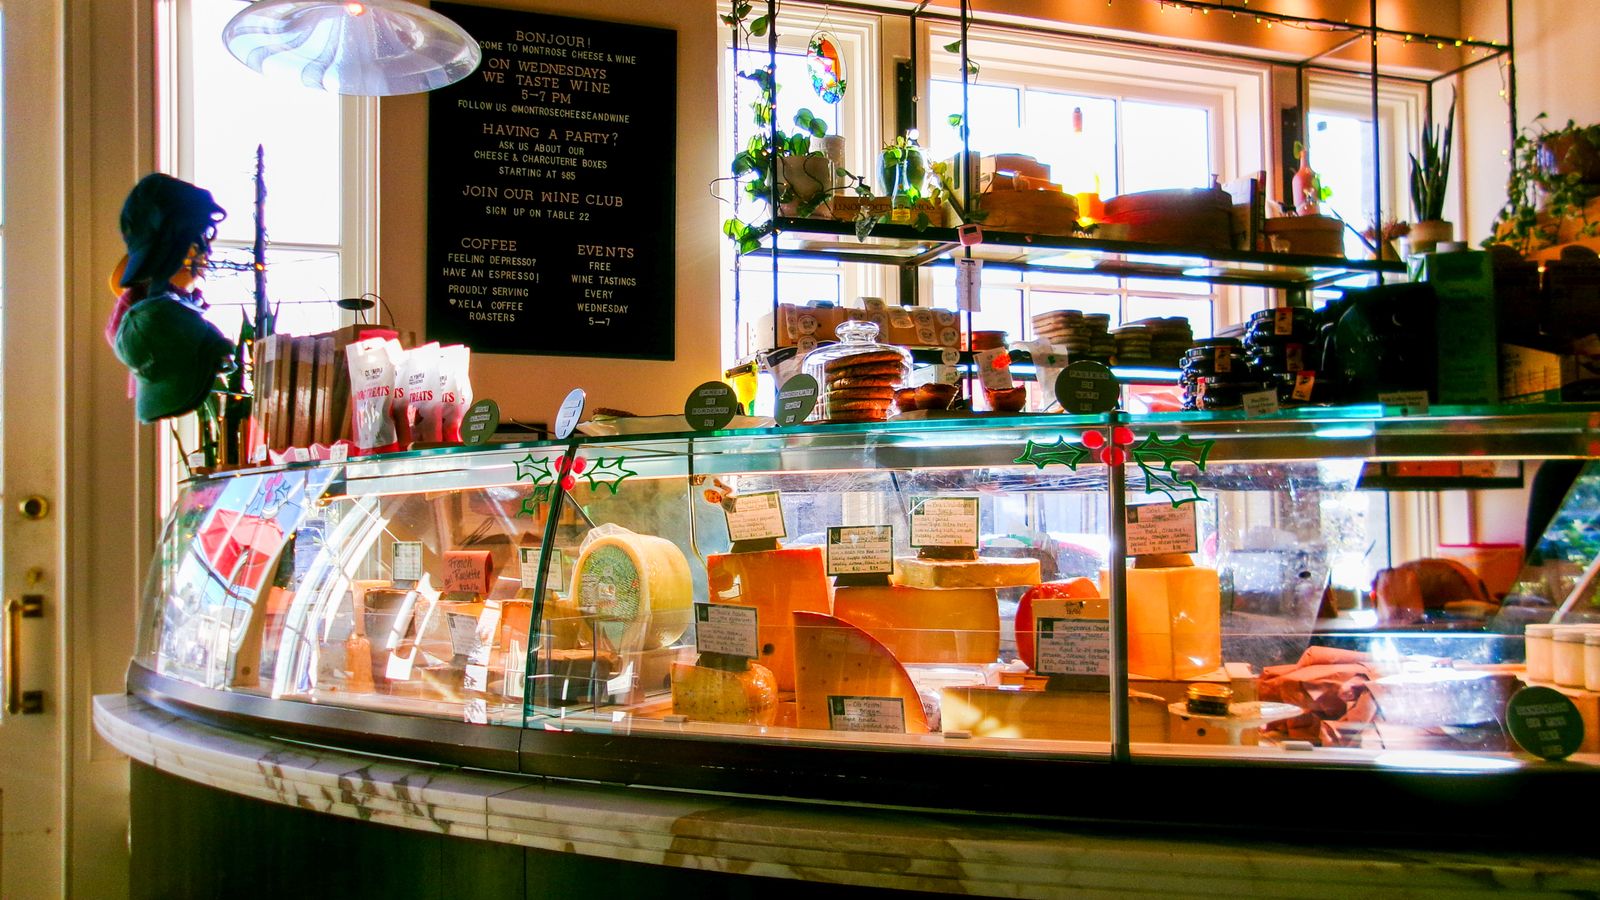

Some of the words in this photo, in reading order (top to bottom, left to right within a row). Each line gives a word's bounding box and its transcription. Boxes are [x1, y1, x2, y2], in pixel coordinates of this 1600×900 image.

[516, 30, 591, 48] BONJOUR!
[479, 41, 503, 51] COME
[507, 43, 518, 53] TO
[523, 45, 566, 57] MONTROSE
[572, 50, 603, 61] CHEESE
[607, 54, 612, 62] &
[615, 55, 636, 64] WINE
[489, 58, 510, 69] ON
[518, 60, 607, 80] WEDNESDAYS
[483, 71, 504, 83] WE
[516, 75, 559, 88] TASTE
[570, 80, 610, 94] WINE
[552, 92, 570, 104] PM
[458, 100, 492, 110] FOLLOW
[511, 105, 629, 123] @MONTROSECHEESEANDWINE
[483, 123, 539, 138] HAVING
[549, 129, 558, 140] A
[566, 130, 618, 146] PARTY?
[499, 141, 514, 149] ASK
[519, 142, 529, 151] US
[534, 144, 561, 153] ABOUT
[568, 146, 584, 155] OUR
[474, 150, 508, 161] CHEESE
[522, 154, 577, 166] CHARCUTERIE
[582, 159, 607, 169] BOXES
[499, 166, 541, 177] STARTING
[546, 170, 556, 178] AT
[561, 171, 576, 180] $85
[463, 185, 497, 197] JOIN
[504, 189, 533, 200] OUR
[542, 192, 579, 204] WINE
[586, 194, 623, 207] CLUB
[486, 206, 506, 215] SIGN
[514, 208, 525, 216] UP
[529, 209, 541, 217] ON
[547, 210, 574, 220] TABLE
[579, 213, 589, 221] 22
[461, 238, 516, 251] COFFEE
[578, 245, 634, 258] EVENTS
[448, 253, 484, 263] FEELING
[490, 256, 536, 266] DEPRESSO?
[589, 261, 611, 271] FREE
[443, 268, 466, 277] HAVE
[471, 269, 483, 277] AN
[489, 270, 539, 283] ESPRESSO!
[571, 275, 593, 284] WINE
[599, 276, 636, 286] TASTINGS
[449, 285, 487, 294] PROUDLY
[492, 287, 528, 297] SERVING
[585, 289, 613, 299] EVERY
[458, 300, 482, 308] XELA
[491, 301, 523, 311] COFFEE
[577, 303, 628, 313] WEDNESDAY
[469, 312, 515, 322] ROASTERS
[410, 390, 433, 403] TREATS
